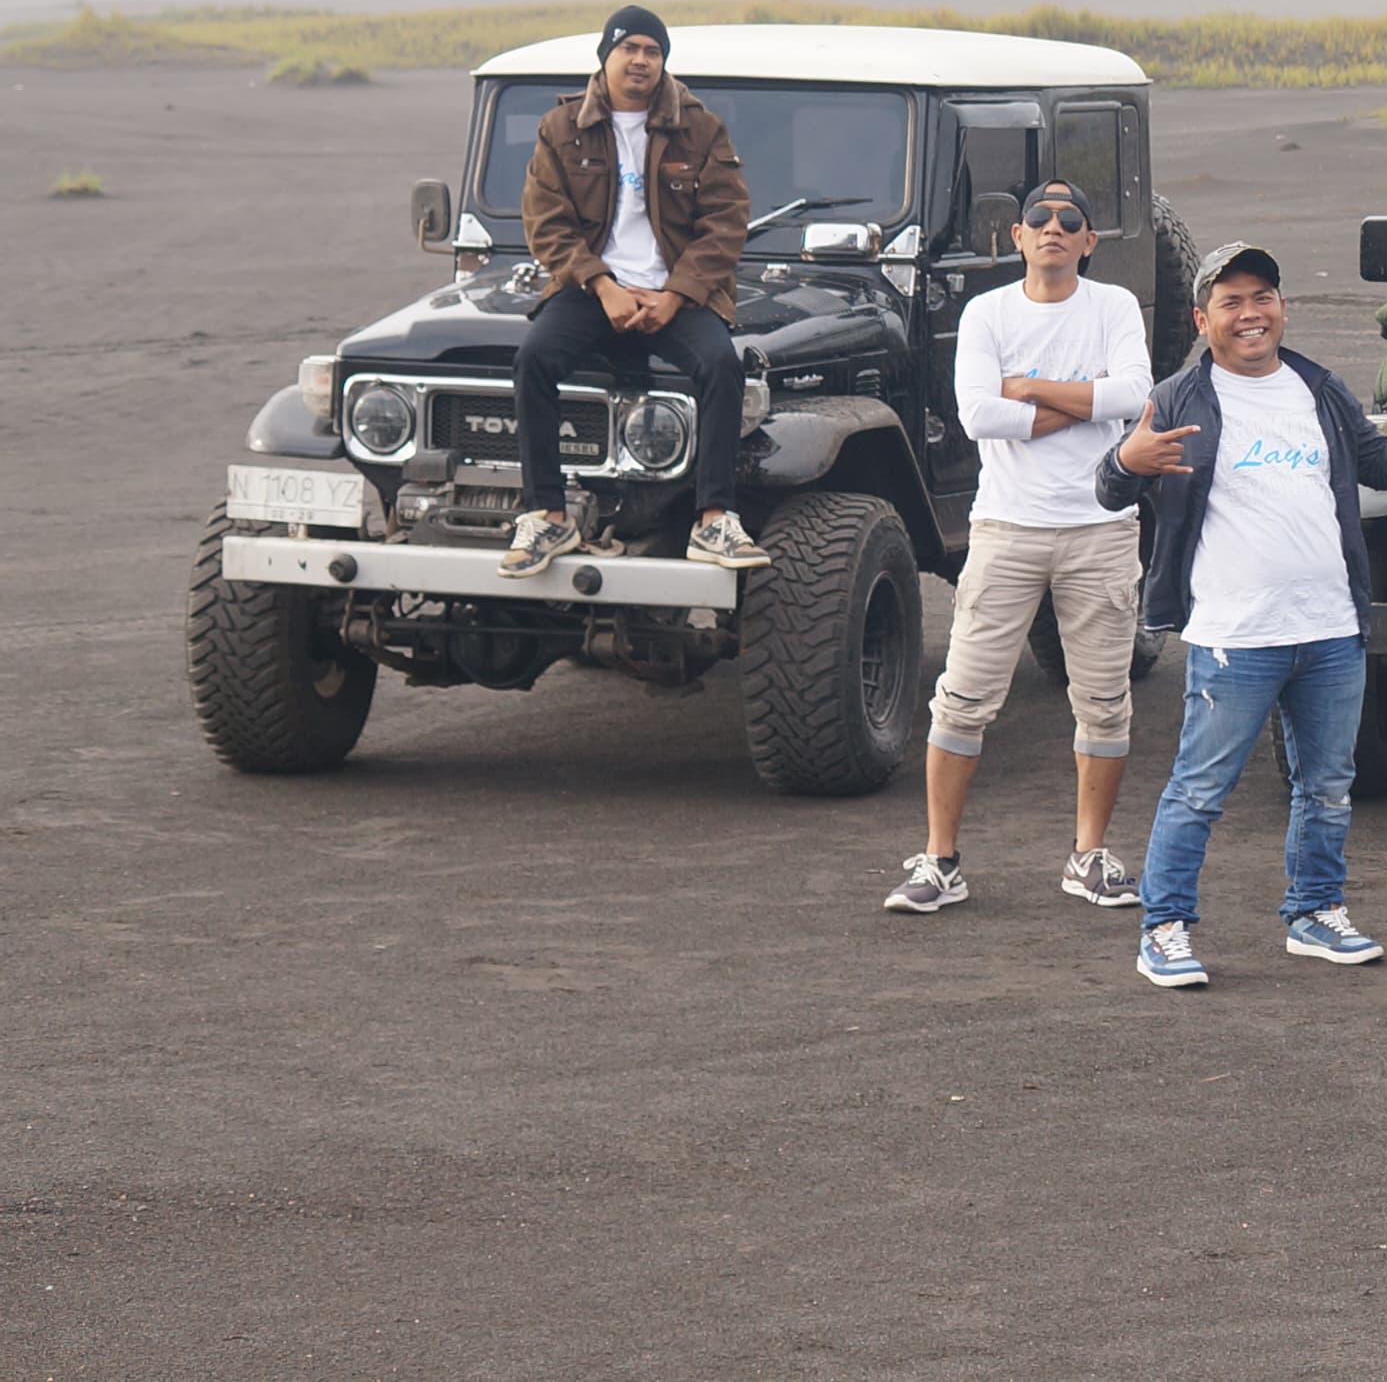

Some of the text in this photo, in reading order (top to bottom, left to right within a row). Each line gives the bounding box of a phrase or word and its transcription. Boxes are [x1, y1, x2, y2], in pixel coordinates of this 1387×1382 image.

[465, 415, 577, 438] TOYA
[560, 443, 597, 455] IESEL
[1231, 439, 1321, 470] Lay's
[233, 474, 249, 499] N
[326, 480, 359, 509] YZ
